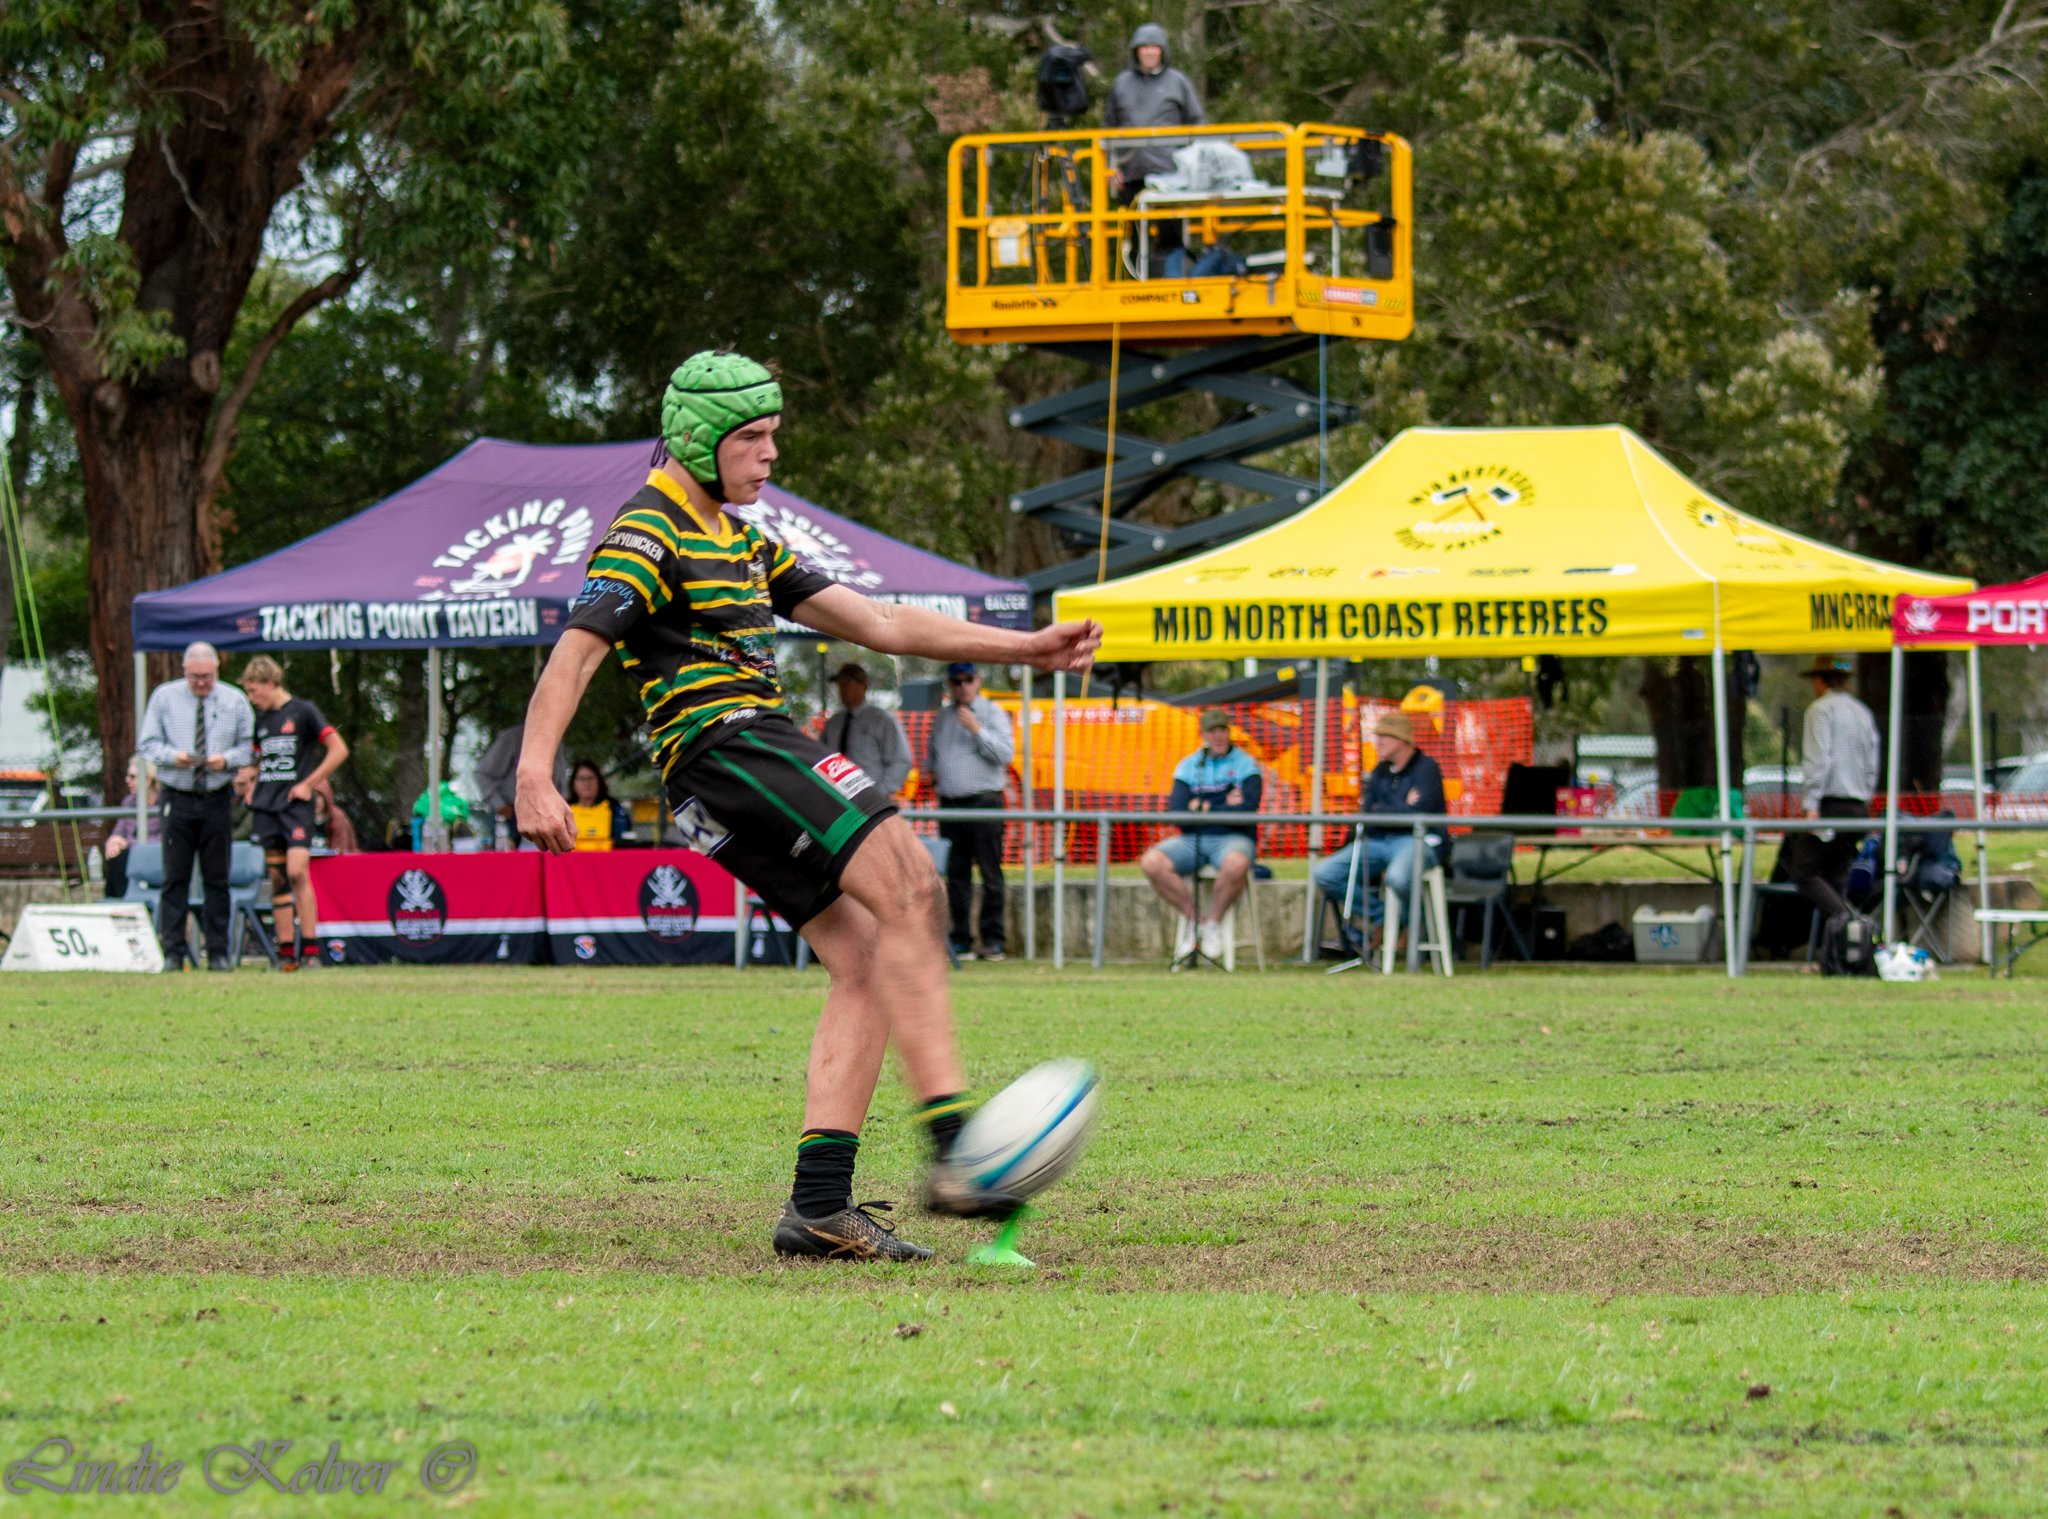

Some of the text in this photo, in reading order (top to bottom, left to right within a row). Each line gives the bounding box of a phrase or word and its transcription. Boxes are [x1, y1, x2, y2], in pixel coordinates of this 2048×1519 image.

[432, 498, 566, 568] TACKING
[259, 603, 366, 641] TACKING
[367, 602, 442, 640] POINT
[445, 599, 539, 638] TAVERN
[1153, 598, 1608, 643] MID NORTH COAST REFEREES
